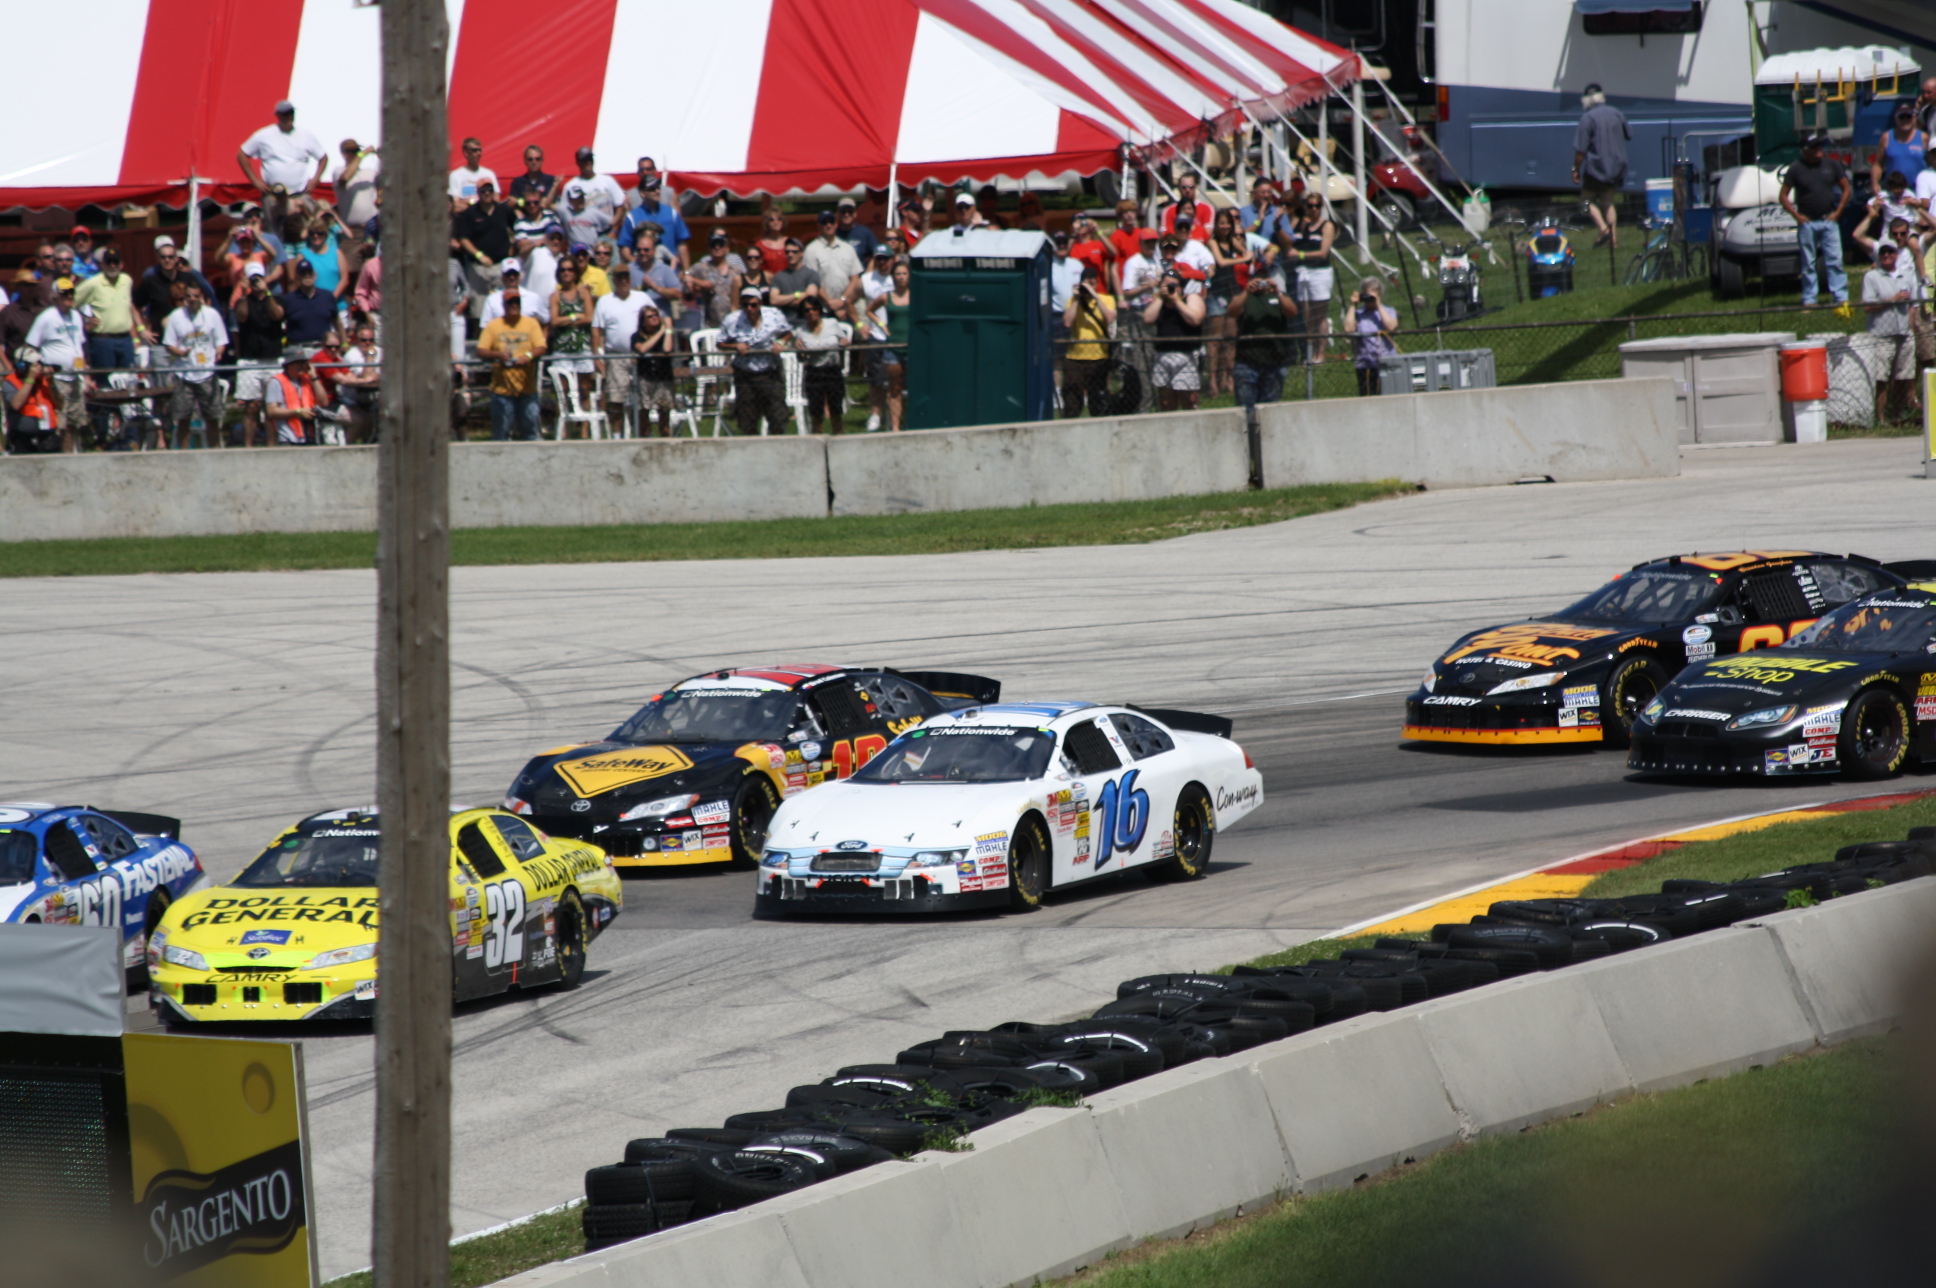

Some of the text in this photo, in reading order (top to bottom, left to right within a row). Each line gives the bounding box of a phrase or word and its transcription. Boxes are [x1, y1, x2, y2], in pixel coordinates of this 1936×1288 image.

[1868, 598, 1925, 609] Nationwide
[1618, 637, 1658, 653] GOODYEAR
[1455, 656, 1484, 666] HOTEL
[1494, 657, 1532, 669] CASINO
[1860, 670, 1900, 686] GOODYEAR
[692, 690, 763, 699] Nationwide
[1563, 685, 1598, 696] MOOG
[1422, 696, 1483, 707] CAMRY
[1564, 695, 1600, 706] MAHLE
[1559, 709, 1576, 721] WIX
[1664, 708, 1732, 722] CHARGER
[941, 727, 1016, 736] Nationwide
[1805, 726, 1832, 736] COMP
[1888, 702, 1910, 772] GOODYEAR
[1789, 746, 1807, 758] WIX
[1810, 748, 1834, 762] JE
[574, 759, 676, 773] SafeWay
[693, 800, 729, 817] MAHLE
[1092, 769, 1151, 872] 16
[683, 832, 701, 845] WIX
[976, 830, 1008, 842] MOOG
[839, 840, 865, 850] Ford
[976, 841, 1008, 855] MAHLE
[521, 857, 572, 892] DOLLAR
[205, 896, 381, 910] DOLLAR
[484, 879, 528, 971] 32
[206, 972, 298, 985] CAMRY
[355, 981, 374, 996] WIX
[143, 1169, 292, 1268] SARGENTO
